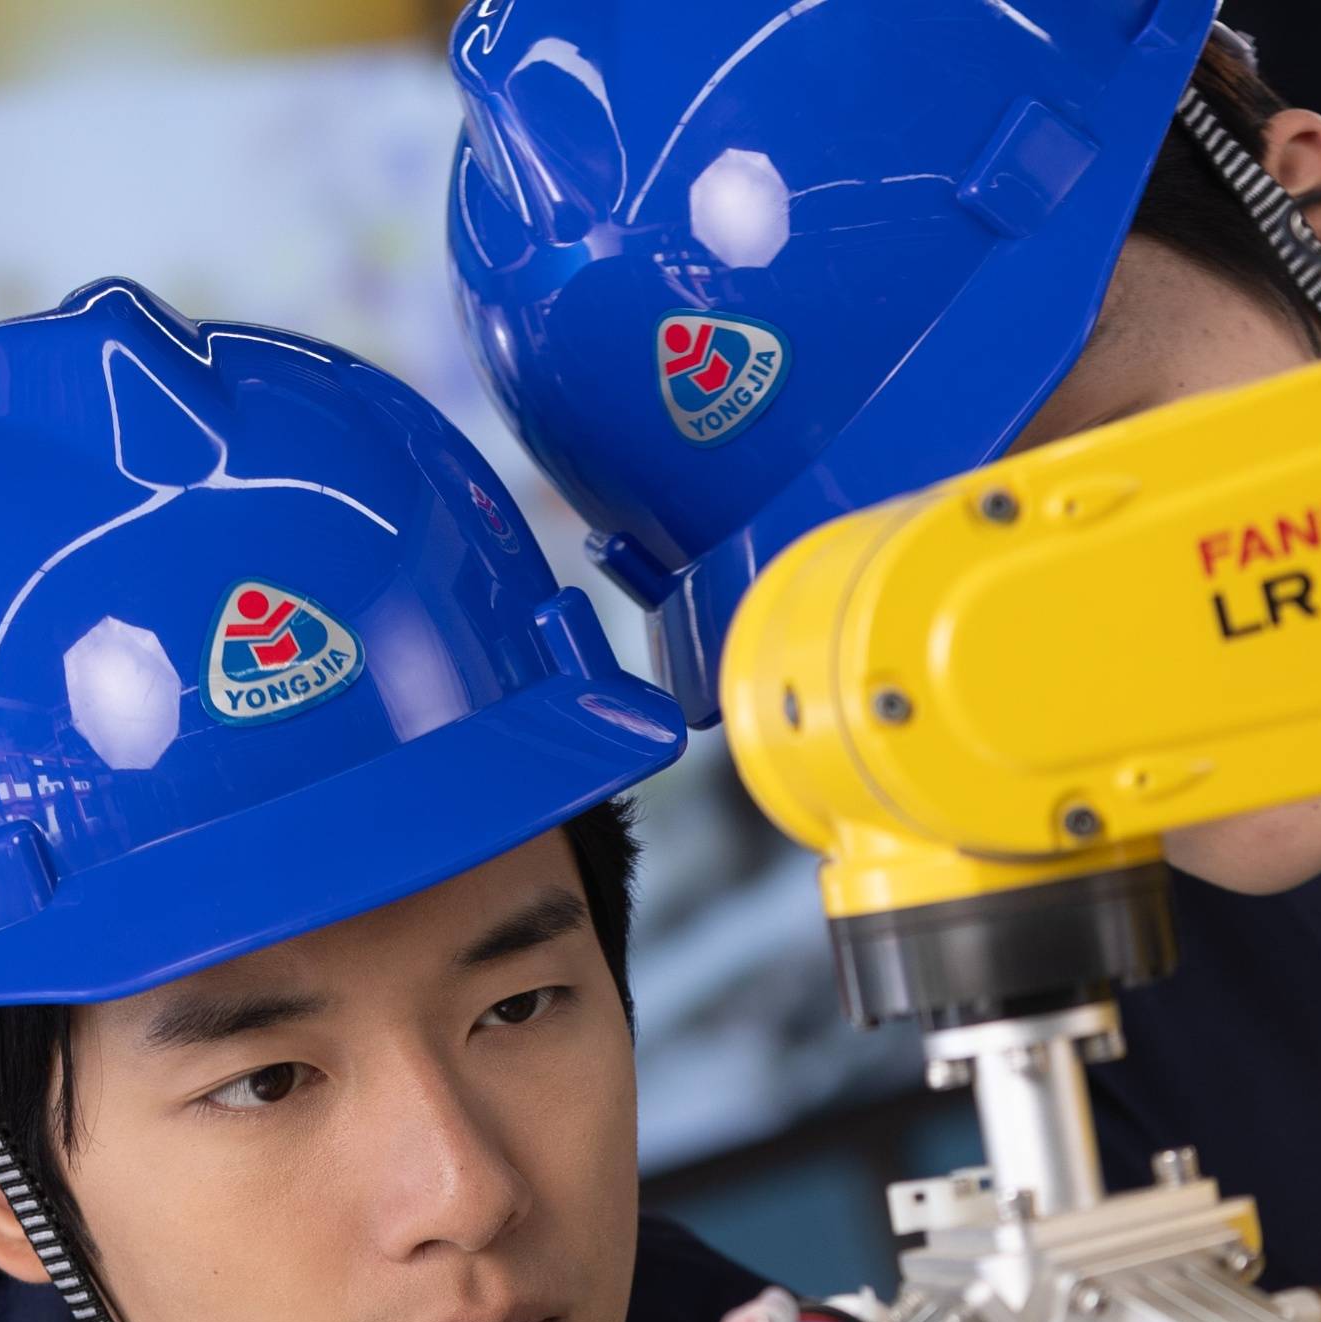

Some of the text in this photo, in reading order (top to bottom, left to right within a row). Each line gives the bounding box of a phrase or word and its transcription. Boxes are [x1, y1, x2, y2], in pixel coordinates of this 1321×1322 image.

[688, 350, 776, 437] YONGJIA
[1211, 569, 1320, 642] LR
[225, 648, 351, 711] YONGJIA
